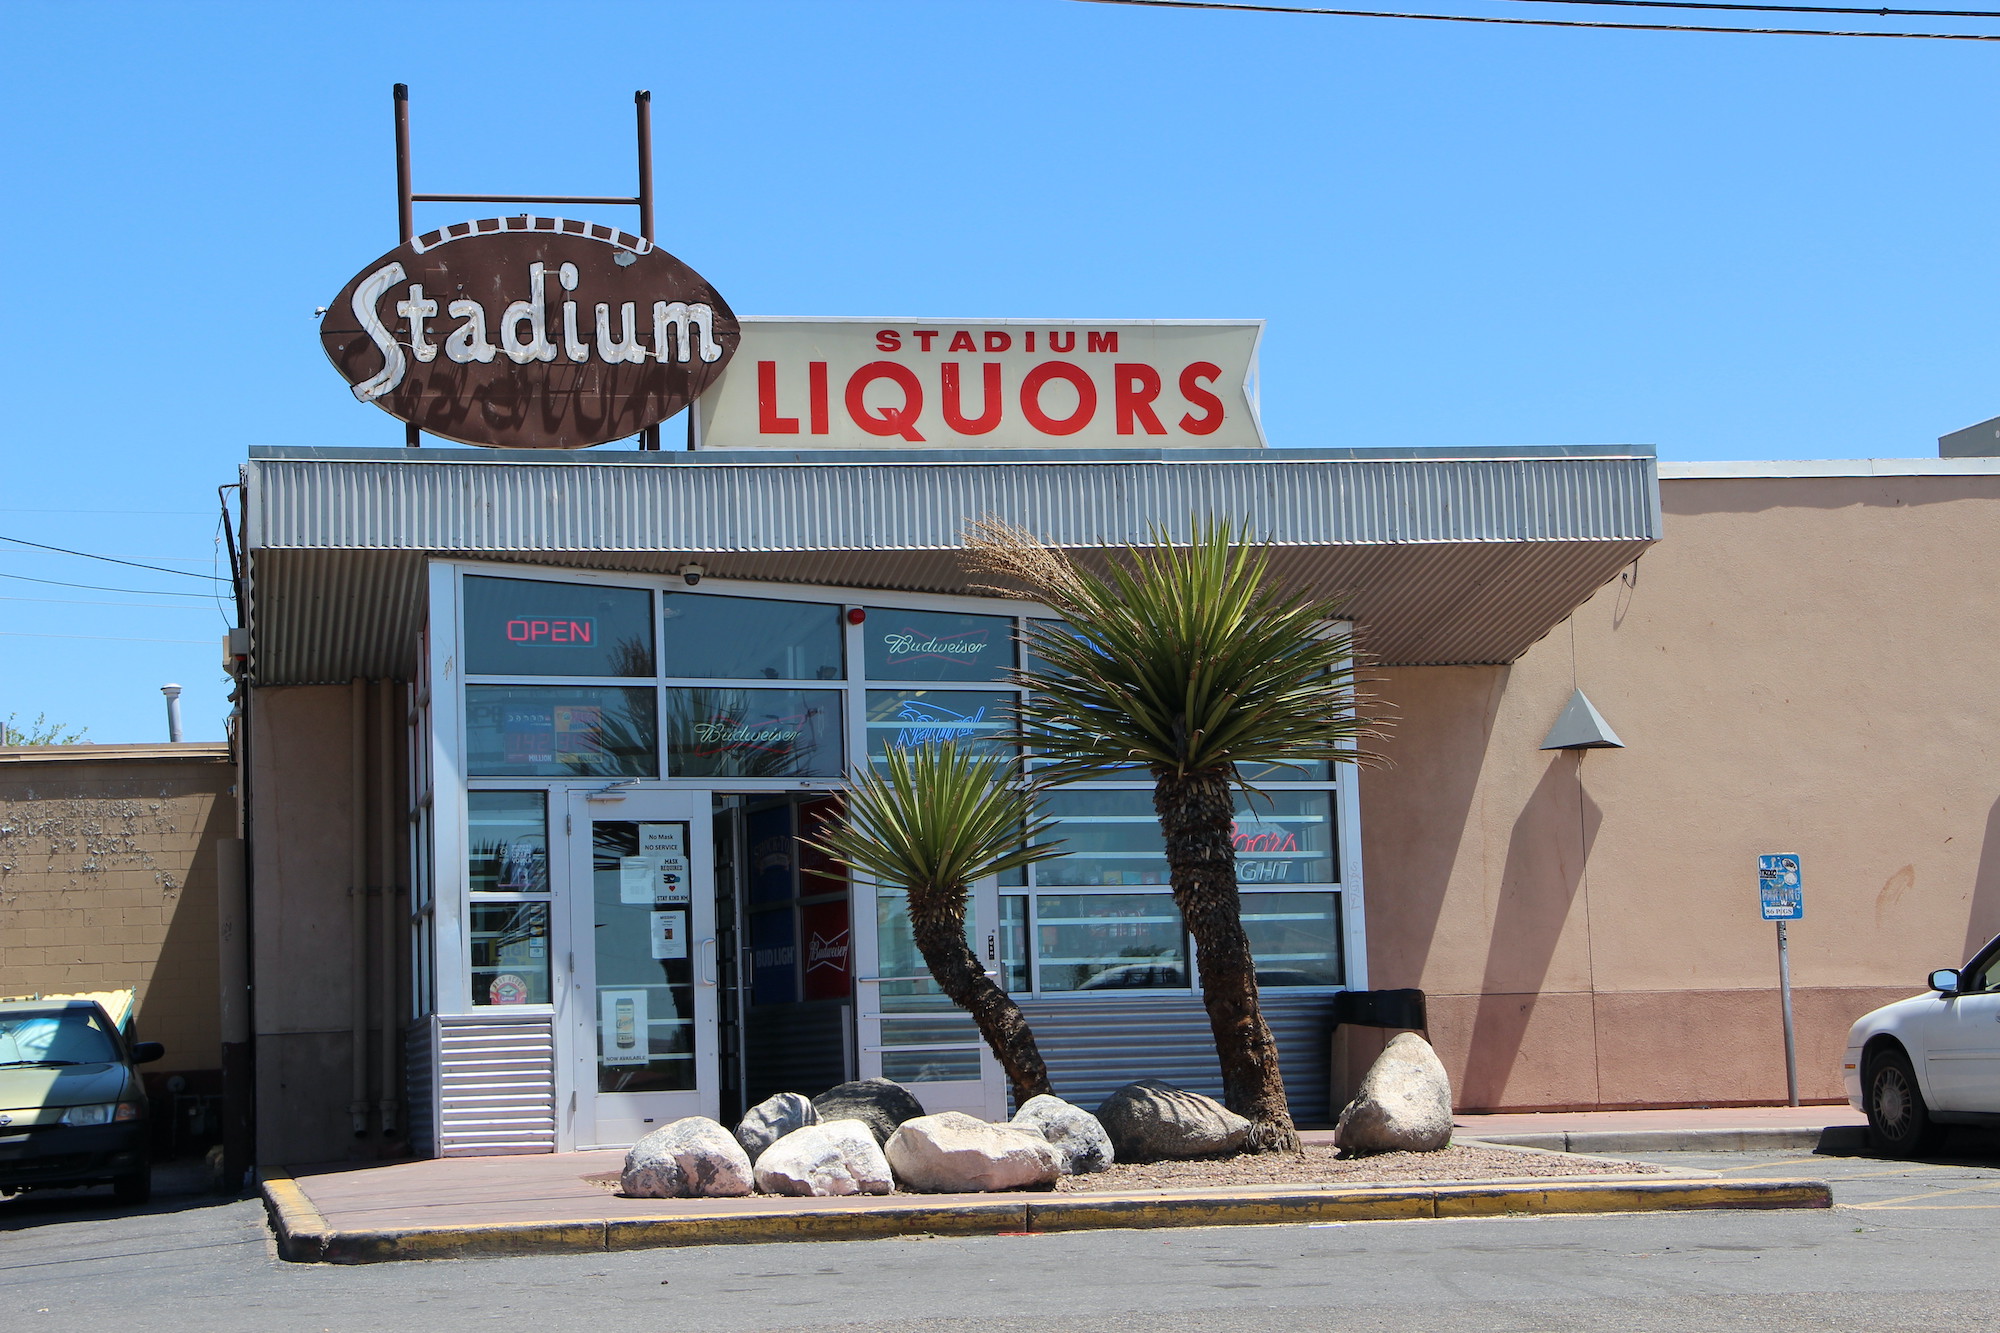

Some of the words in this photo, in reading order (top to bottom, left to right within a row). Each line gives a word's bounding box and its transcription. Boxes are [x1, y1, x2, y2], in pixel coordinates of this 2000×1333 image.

[350, 261, 724, 403] Stadium
[875, 329, 1119, 353] STADIUM
[757, 360, 1225, 442] LIQUORS
[506, 619, 591, 643] OPEN
[884, 633, 988, 655] Budweiser
[694, 723, 802, 743] Budweiser
[528, 754, 552, 762] MILLION
[1230, 822, 1298, 853] oors
[1234, 860, 1294, 881] IGHT
[756, 949, 773, 968] BUD
[809, 940, 849, 962] Budweiser
